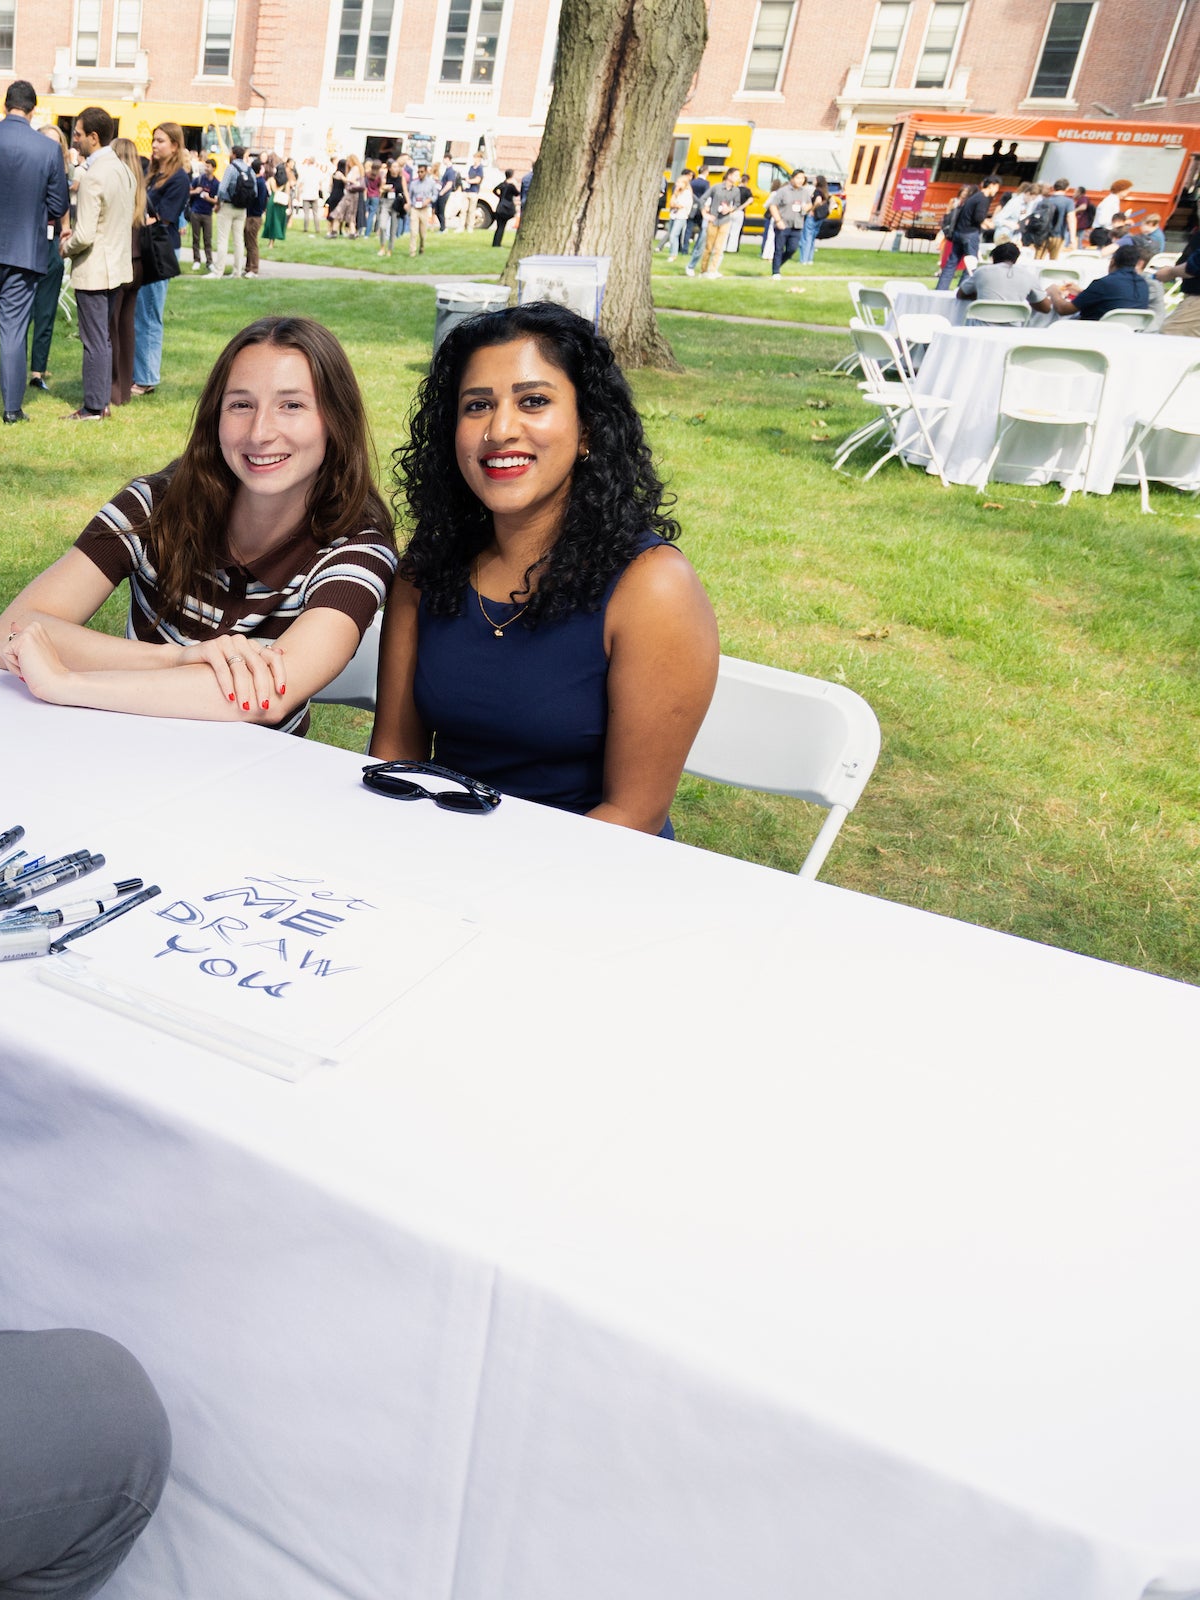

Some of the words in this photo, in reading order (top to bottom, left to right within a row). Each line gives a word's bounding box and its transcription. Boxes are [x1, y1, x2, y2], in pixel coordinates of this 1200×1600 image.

[1057, 128, 1114, 141] WELCOME
[1115, 131, 1132, 142] TO
[1133, 132, 1159, 143] BON
[1160, 133, 1184, 144] ME!
[150, 900, 363, 978] DRAW
[202, 886, 345, 937] ME
[153, 934, 293, 998] YOU
